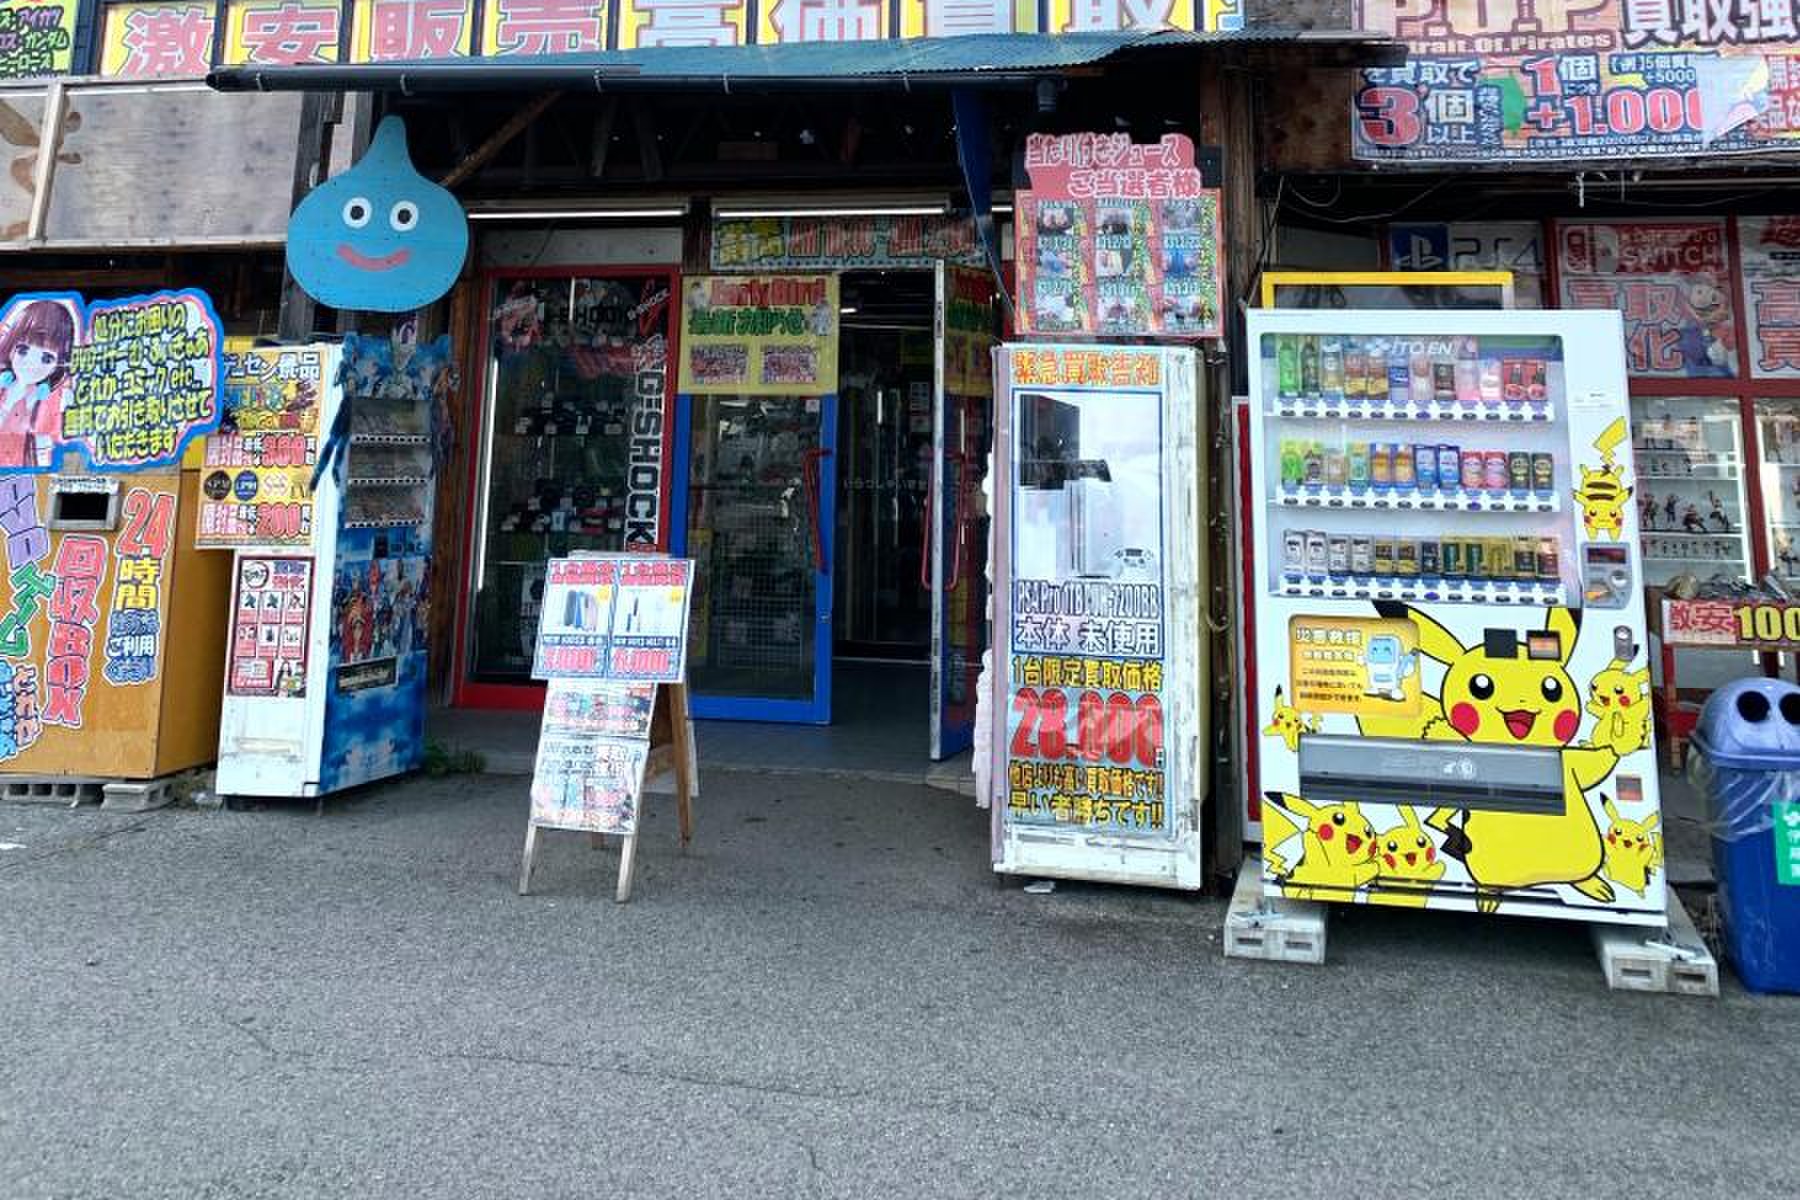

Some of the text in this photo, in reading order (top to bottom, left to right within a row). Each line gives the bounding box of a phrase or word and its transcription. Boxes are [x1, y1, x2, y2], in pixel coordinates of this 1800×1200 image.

[1623, 246, 1719, 272] SWITCH
[623, 368, 667, 546] G-SHOCK
[1016, 616, 1162, 656] 本体 未使用
